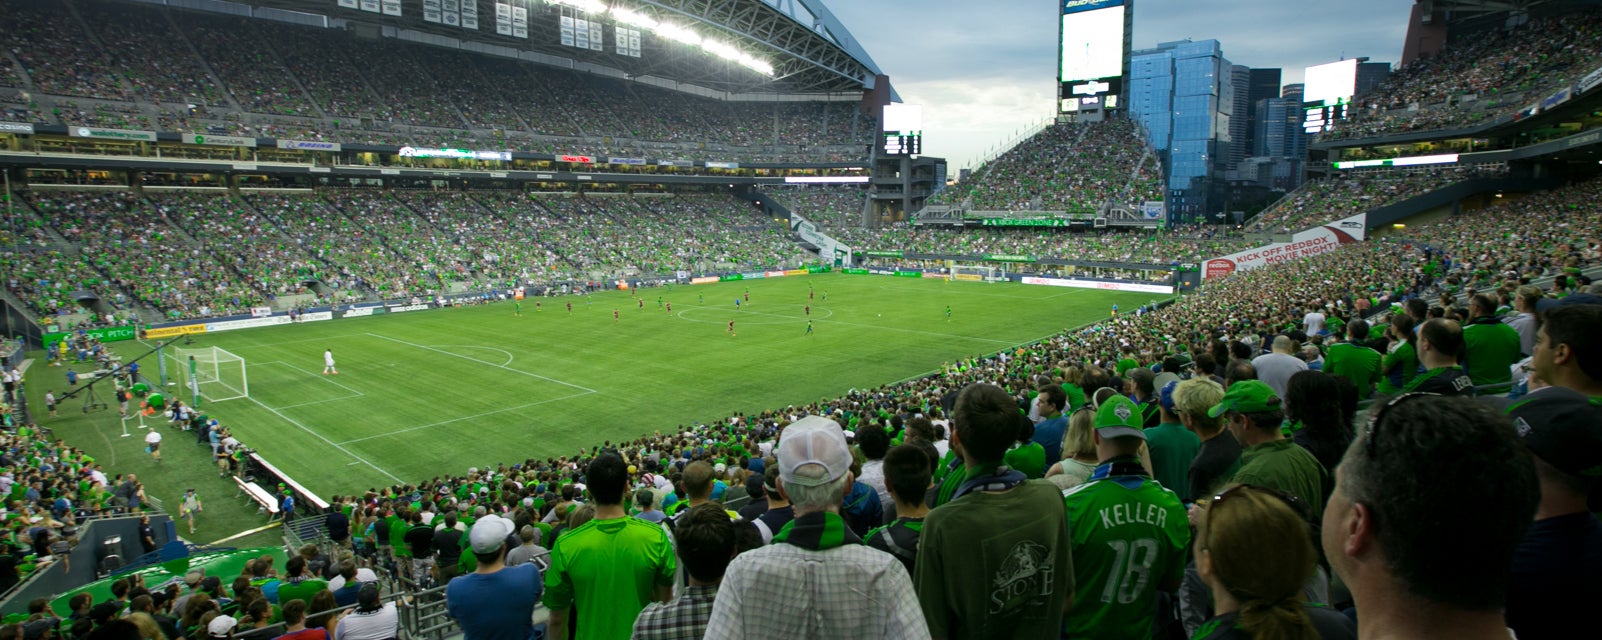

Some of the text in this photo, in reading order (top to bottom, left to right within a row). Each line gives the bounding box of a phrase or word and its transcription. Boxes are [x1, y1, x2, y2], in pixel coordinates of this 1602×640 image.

[1236, 236, 1328, 264] KICK OFF REDBOX
[1266, 250, 1299, 264] MOVIE
[107, 328, 134, 338] PITCH
[1099, 502, 1167, 529] KELLER
[1101, 538, 1158, 604] 18
